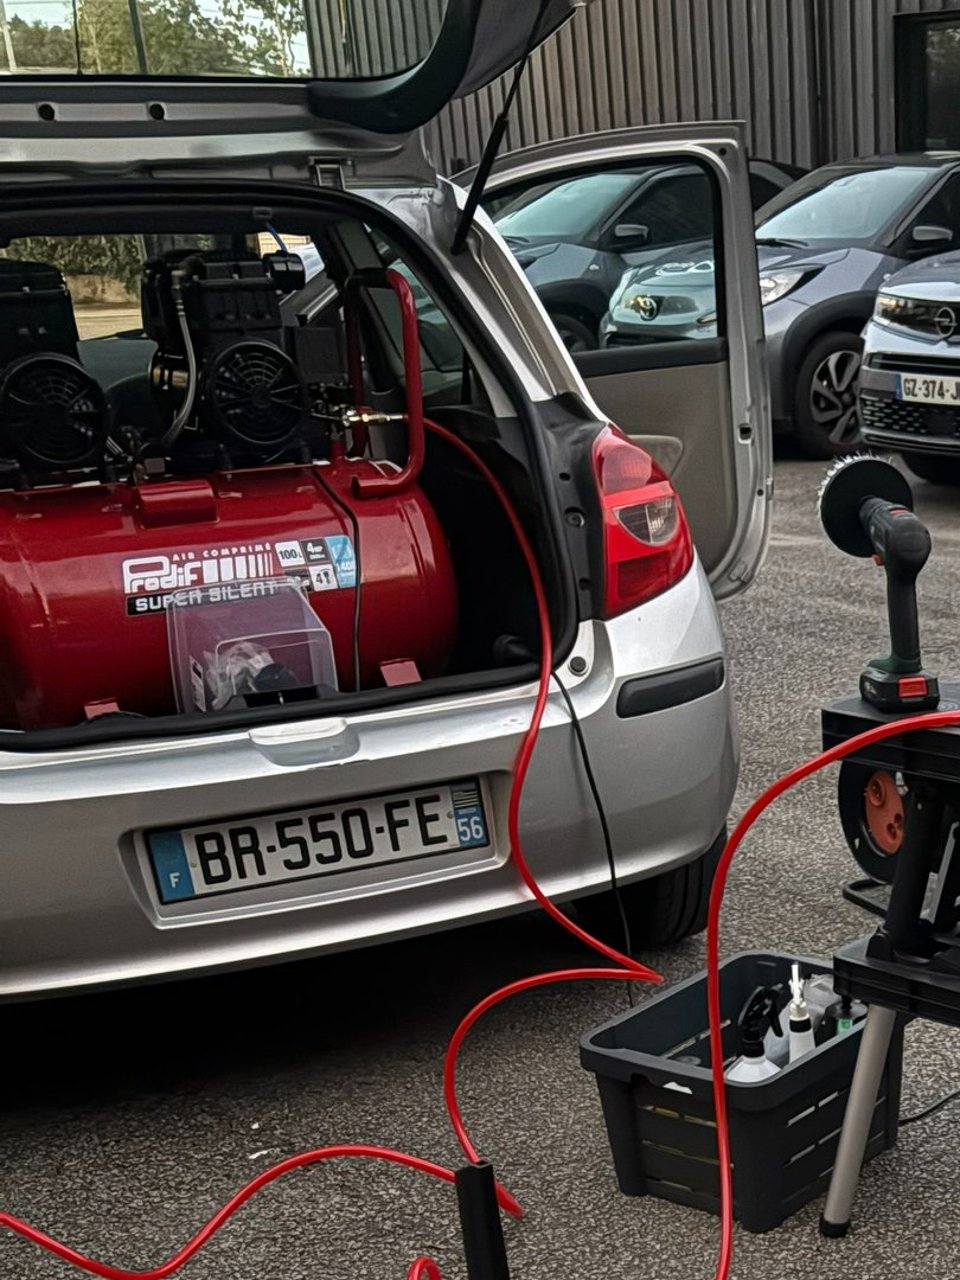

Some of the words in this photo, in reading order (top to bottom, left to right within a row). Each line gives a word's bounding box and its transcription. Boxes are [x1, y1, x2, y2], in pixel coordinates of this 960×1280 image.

[172, 552, 195, 562] AIR
[203, 542, 272, 558] COMPRIMÉ
[135, 588, 203, 612] SUPER
[209, 580, 279, 602] SILENT
[194, 794, 448, 885] BR-550-FE
[457, 816, 484, 842] 56
[169, 871, 180, 888] F
